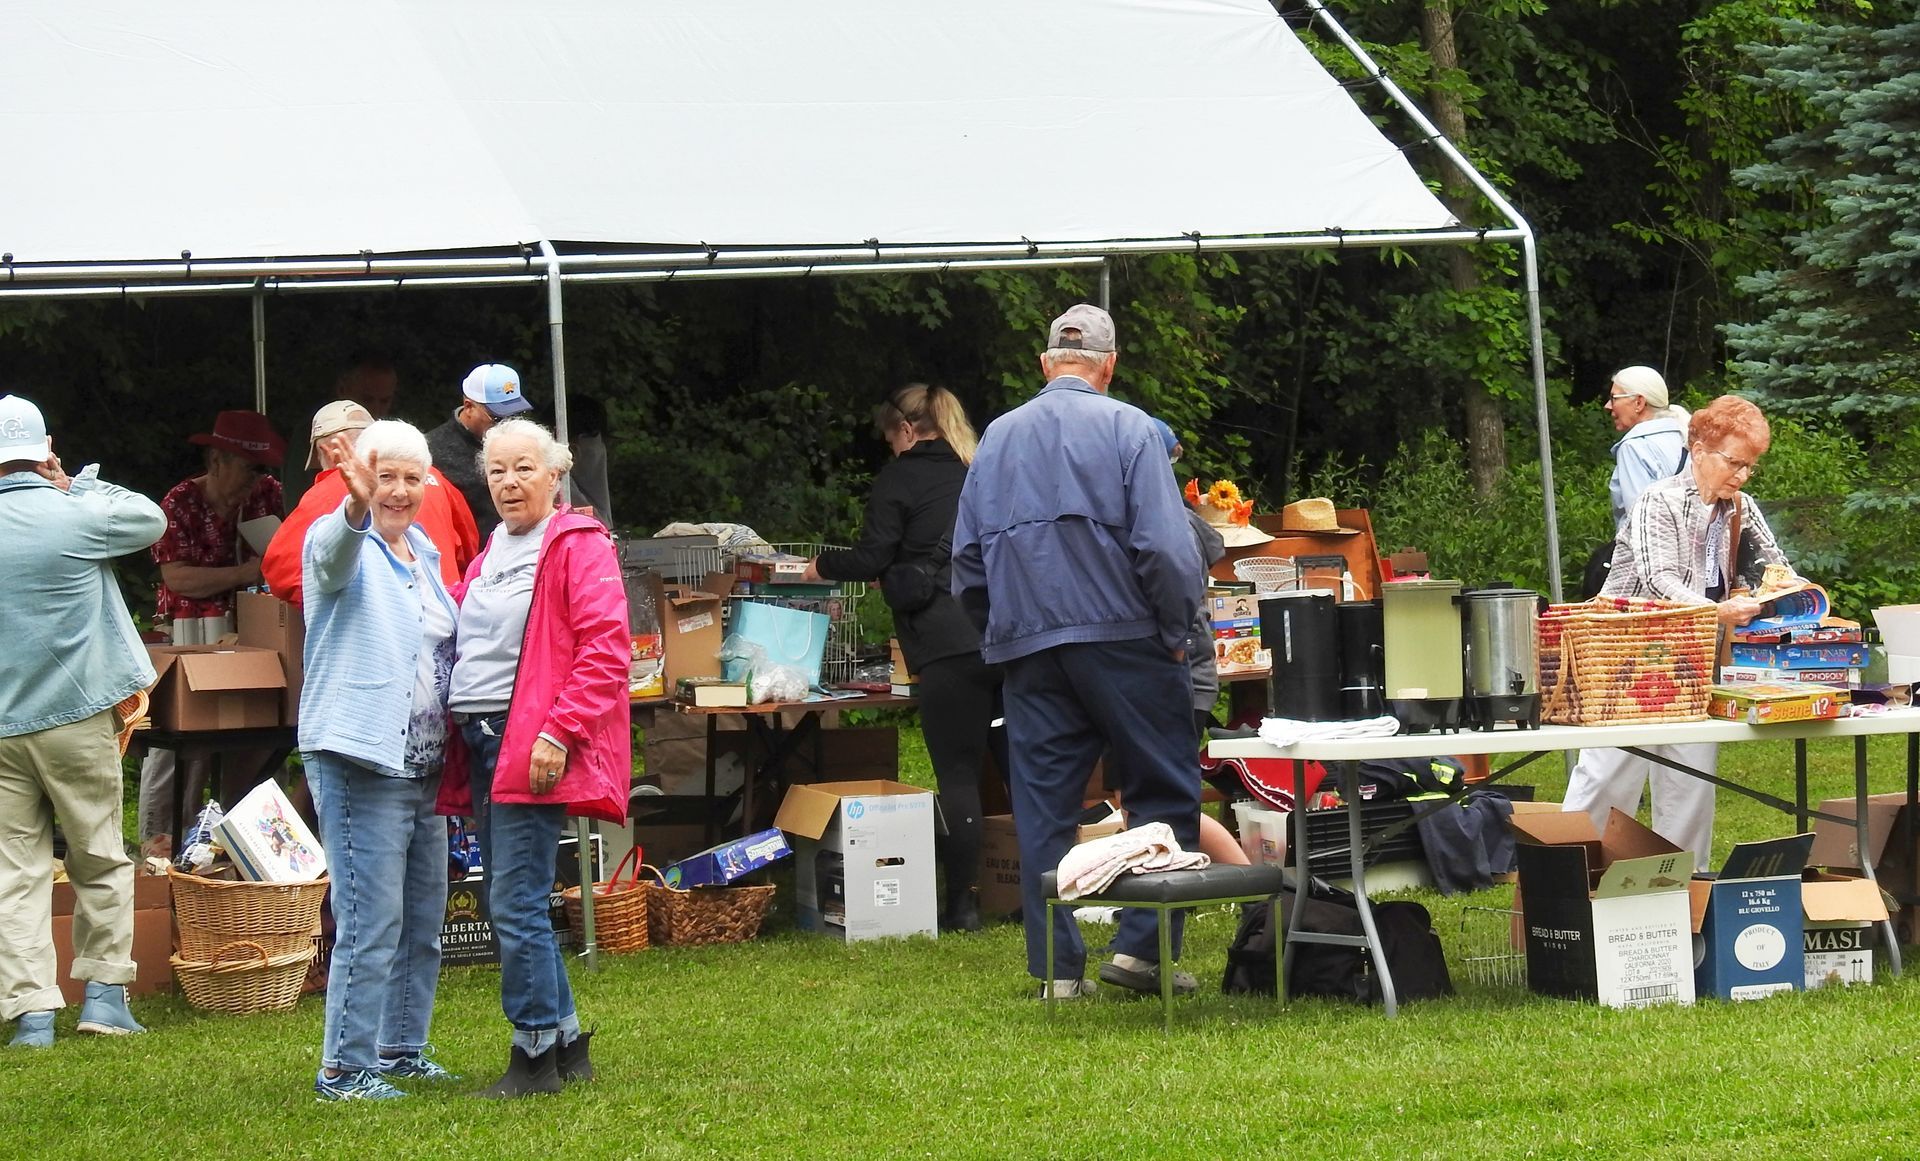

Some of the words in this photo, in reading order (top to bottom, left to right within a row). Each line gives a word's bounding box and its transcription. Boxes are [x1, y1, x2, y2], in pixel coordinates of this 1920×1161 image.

[1802, 648, 1849, 658] PICTIONARY
[1800, 672, 1845, 682] MONOPOLY
[1773, 703, 1811, 720] scene
[1811, 697, 1829, 716] it?
[848, 801, 864, 819] hp
[1001, 858, 1010, 870] DE
[1750, 905, 1780, 913] GIOVELLO
[444, 921, 490, 934] LBERTA
[1531, 926, 1549, 938] BREAD
[1554, 929, 1581, 941] BUTTER
[1743, 927, 1776, 939] PRODUCT
[441, 932, 492, 945] REMIUM
[1608, 933, 1637, 944] BREAD
[1638, 932, 1644, 941] &
[1646, 928, 1678, 940] BUTTER
[1803, 930, 1862, 951] MASI
[1618, 948, 1643, 958] BREAD
[1650, 944, 1678, 954] BUTTER
[1756, 943, 1766, 951] OF
[1627, 952, 1670, 963] CHARDONNAY
[1624, 960, 1656, 970] CALIFORNIA
[1752, 960, 1770, 968] ITALY
